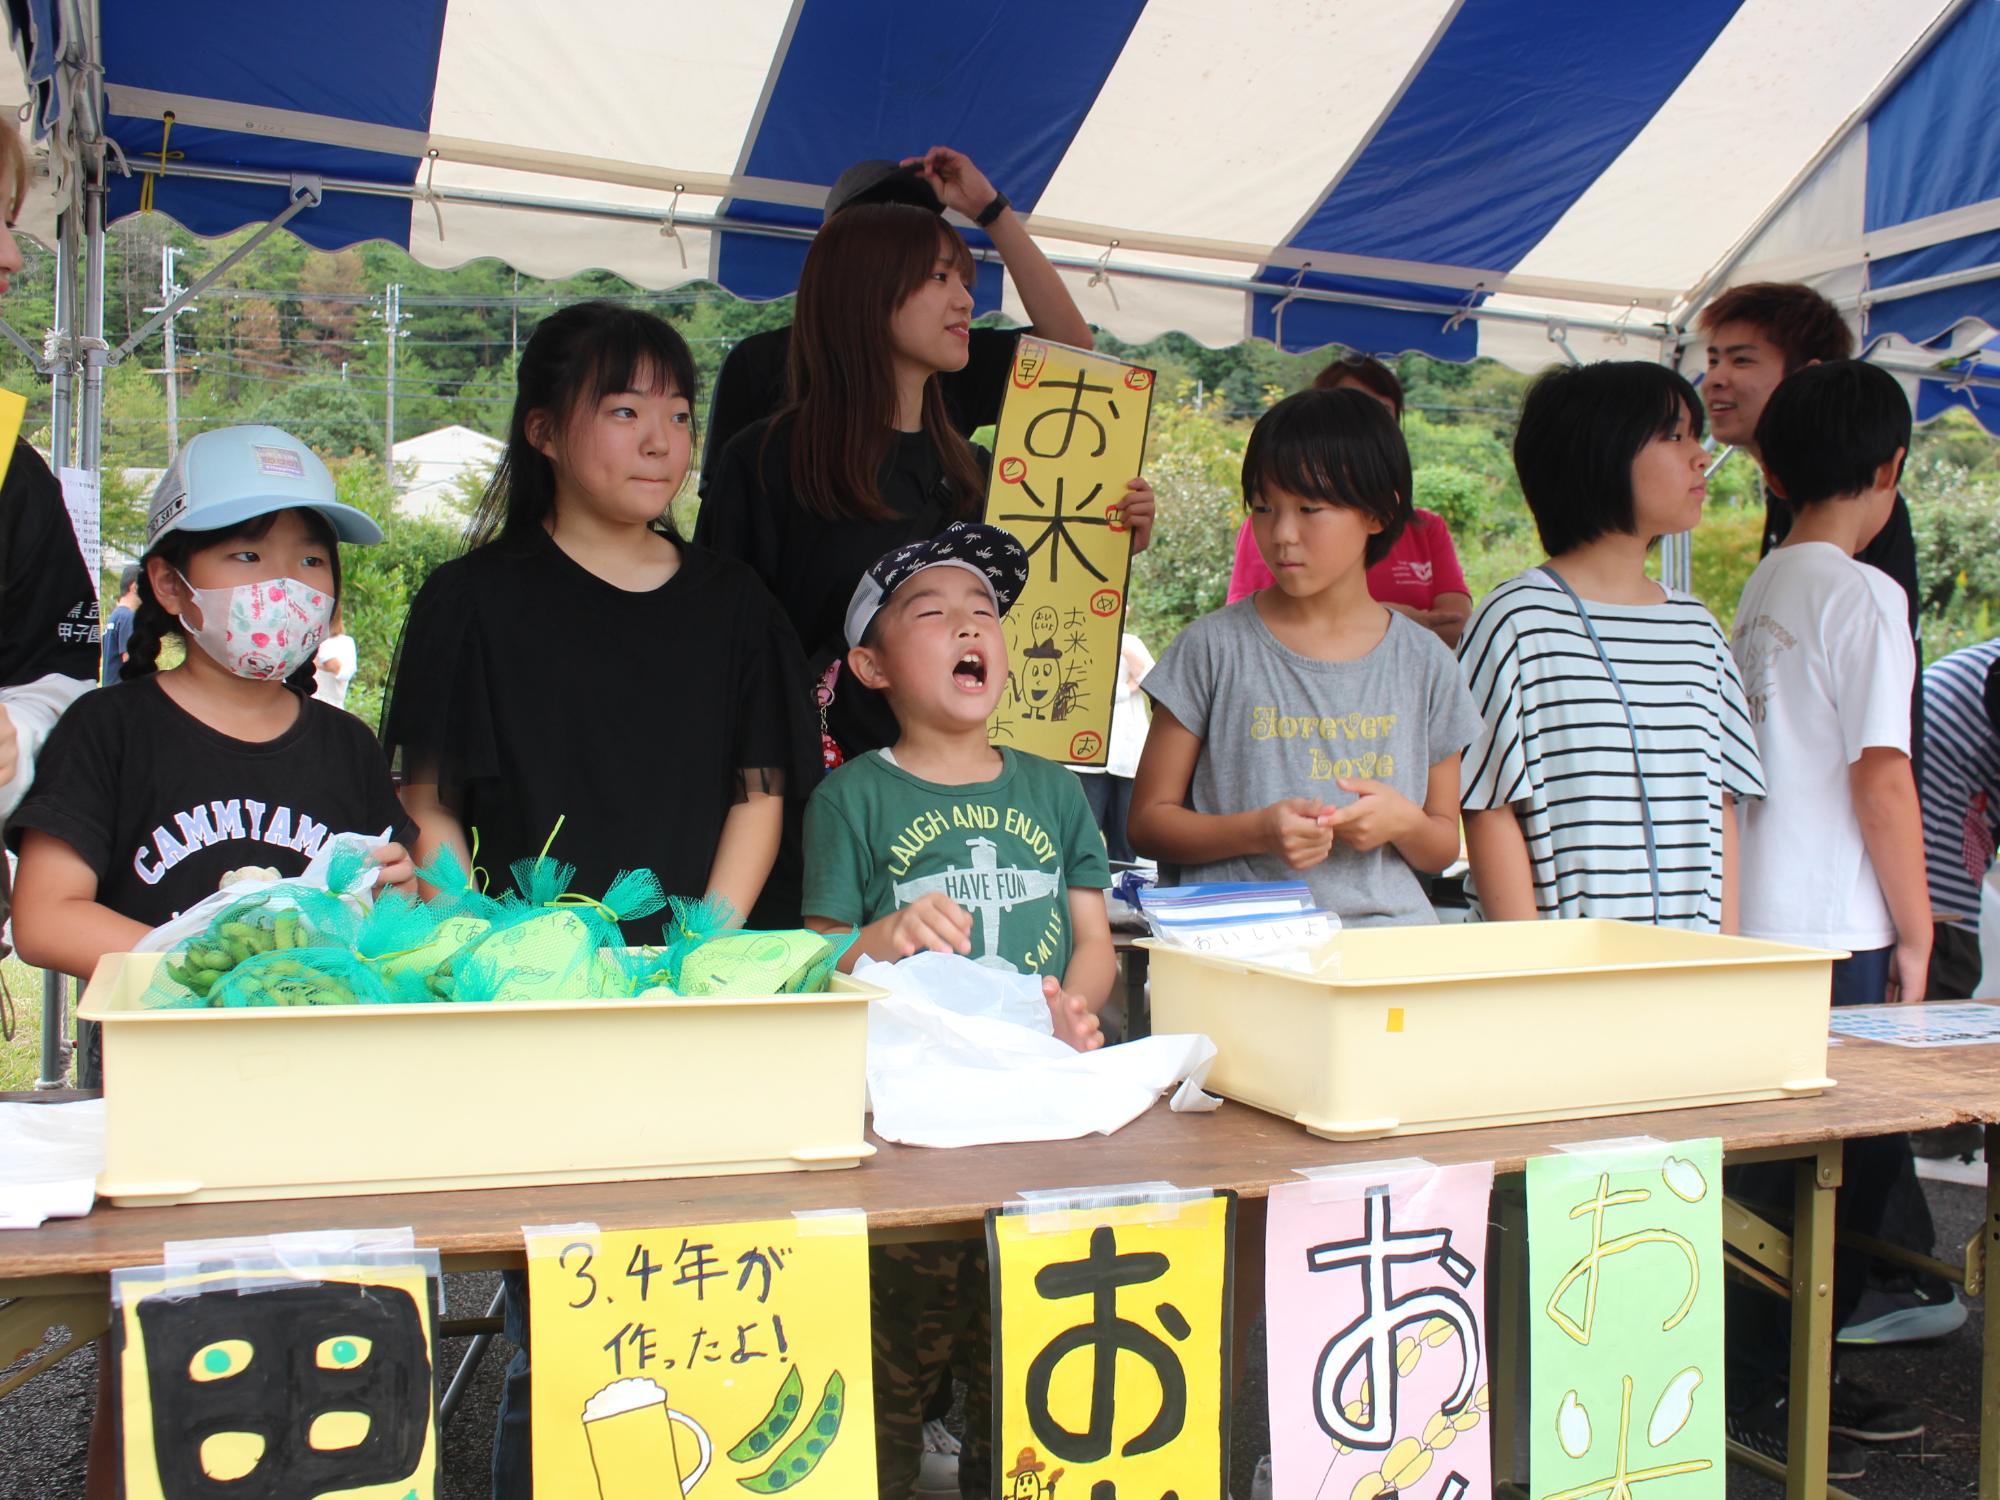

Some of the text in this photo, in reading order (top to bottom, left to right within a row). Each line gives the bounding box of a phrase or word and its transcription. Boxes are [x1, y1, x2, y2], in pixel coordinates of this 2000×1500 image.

[999, 368, 1120, 582] お米
[1307, 748, 1394, 781] Love
[133, 799, 334, 885] CAMMYAM
[888, 803, 1057, 877] LAUGH AND ENJOY
[945, 872, 1028, 901] HAVE FUN
[1194, 920, 1321, 950] おいしいよ
[1026, 1224, 1192, 1500] お
[1307, 1185, 1481, 1500] お
